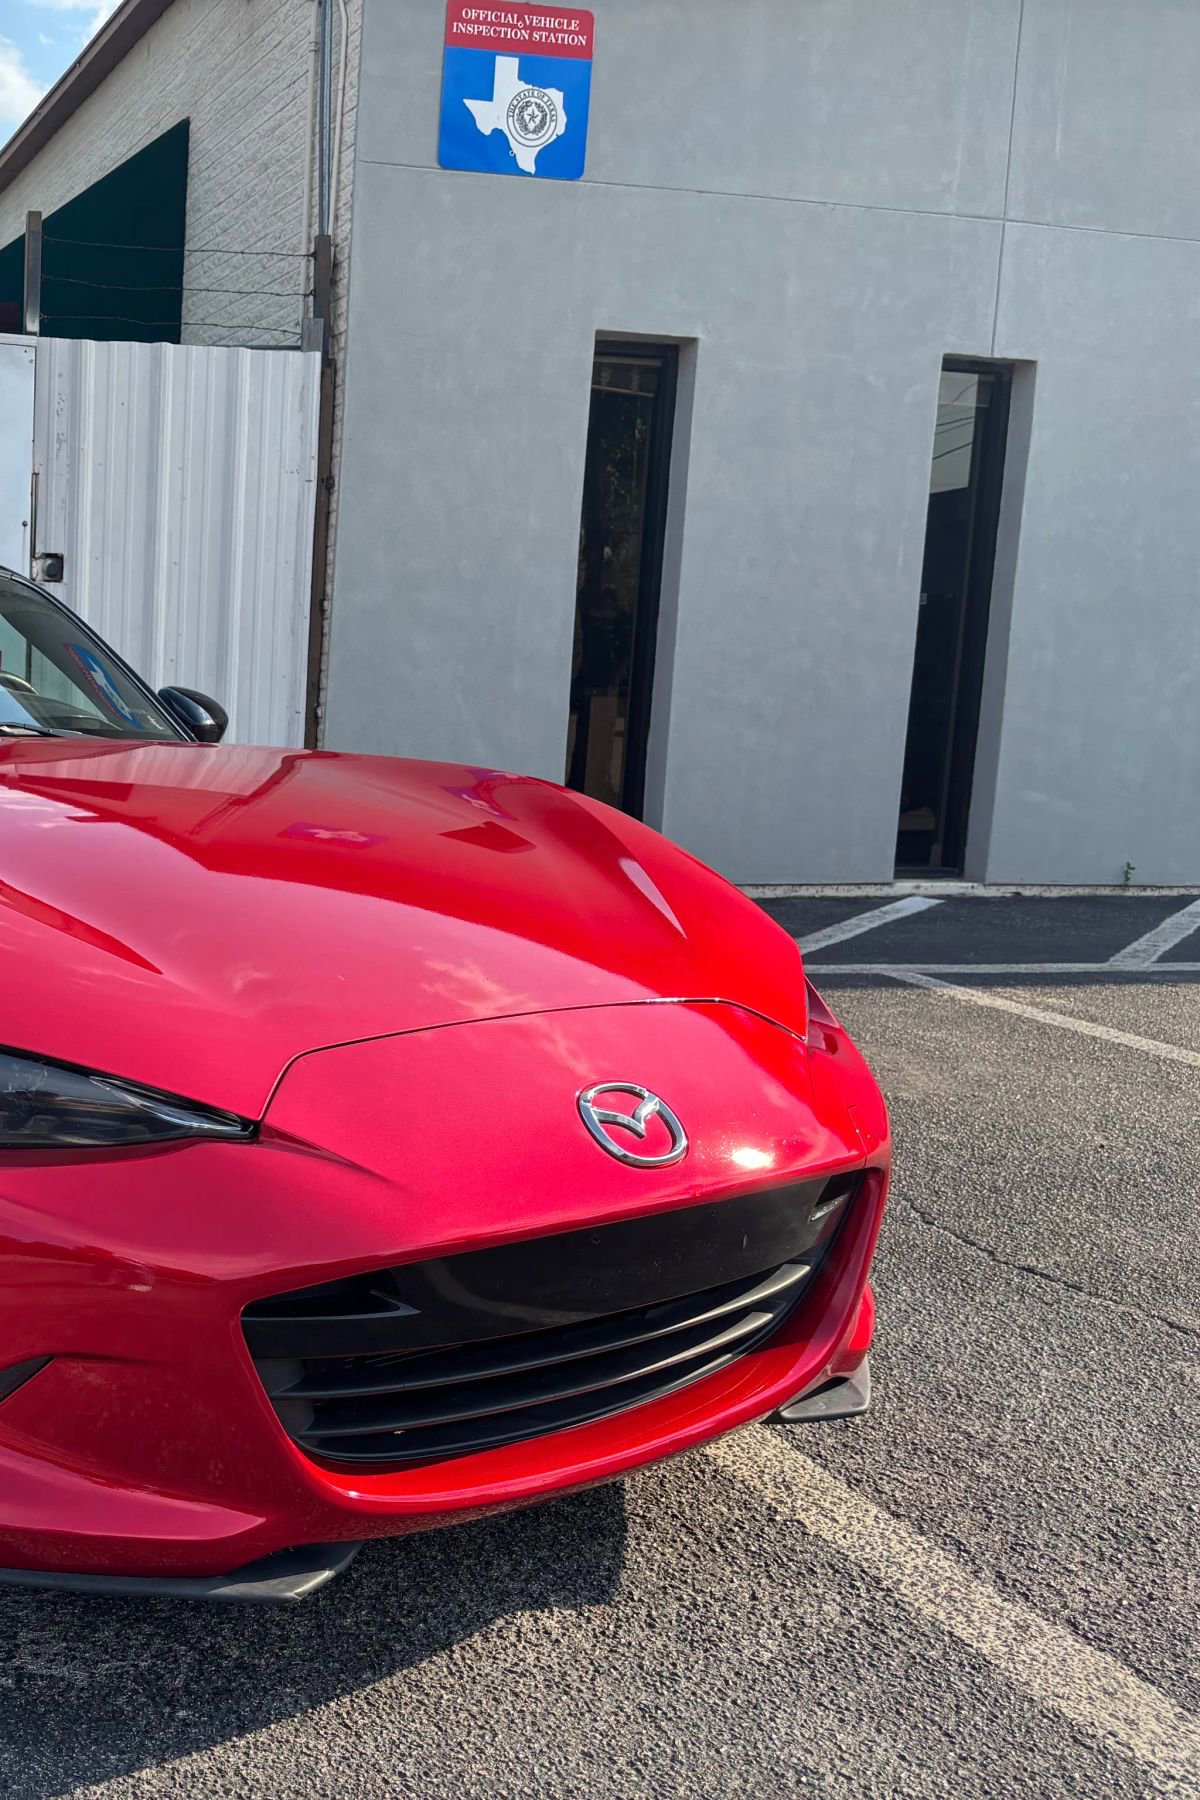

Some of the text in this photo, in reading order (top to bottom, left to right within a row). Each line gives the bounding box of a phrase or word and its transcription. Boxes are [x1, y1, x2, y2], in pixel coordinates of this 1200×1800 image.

[462, 8, 580, 31] OFFICIAL VEHICLE
[452, 22, 587, 46] INSPECTION STATION
